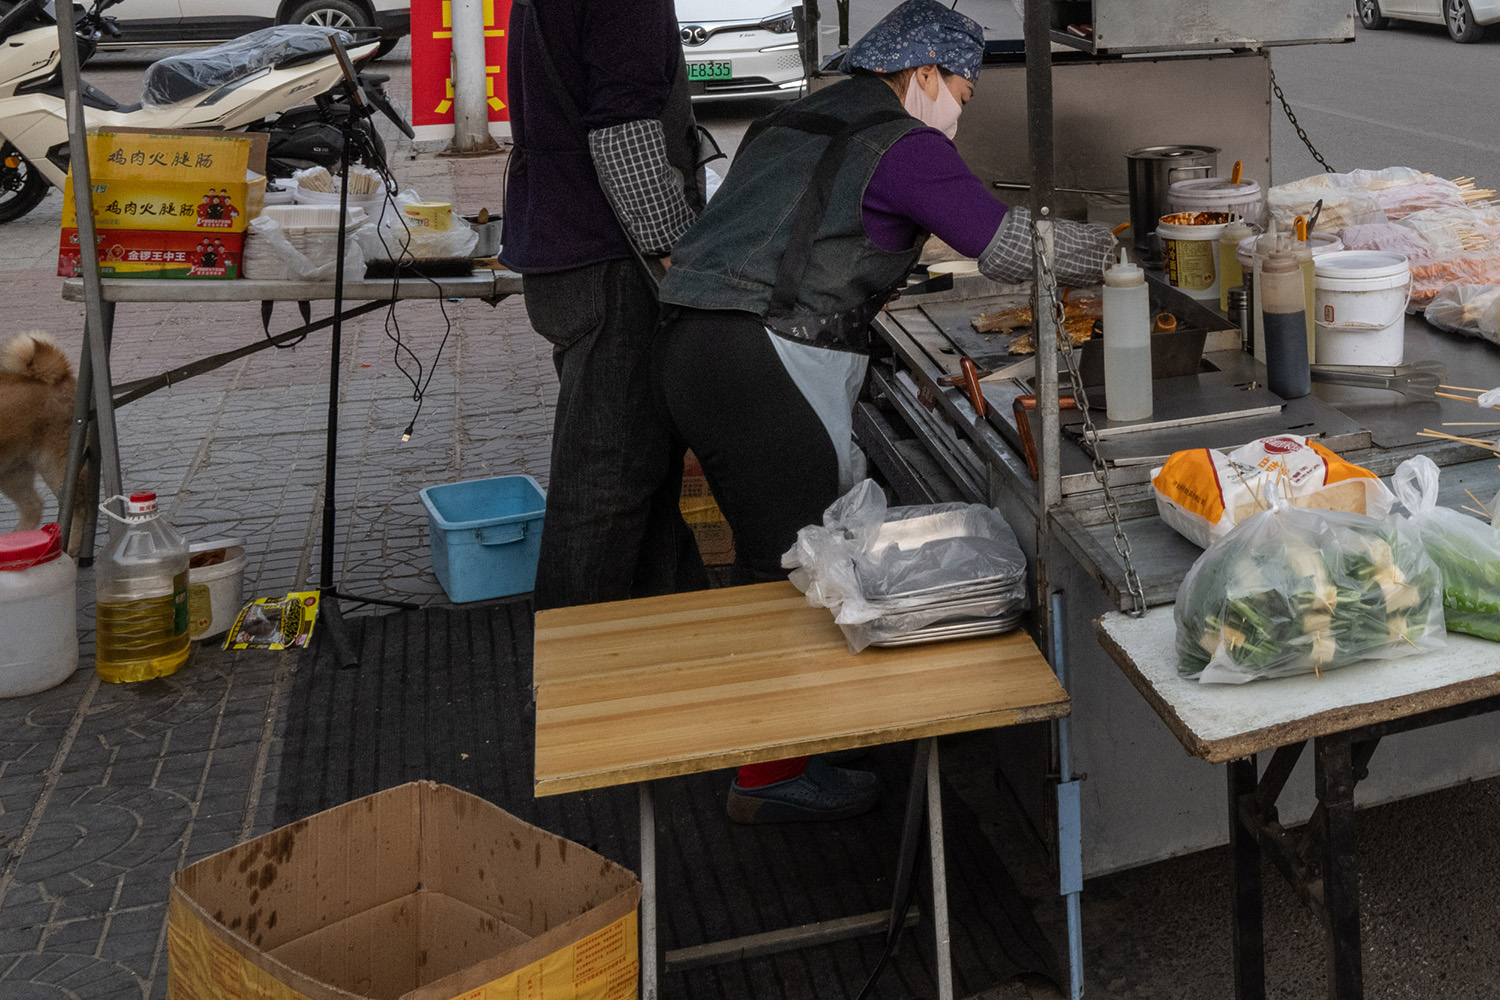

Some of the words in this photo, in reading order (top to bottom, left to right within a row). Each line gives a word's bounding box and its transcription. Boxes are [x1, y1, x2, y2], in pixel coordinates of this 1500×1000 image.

[107, 148, 213, 169] 鸡肉火腿肠
[105, 200, 194, 217] 鸡肉火腿肠
[127, 250, 186, 262] 金锣王中王
